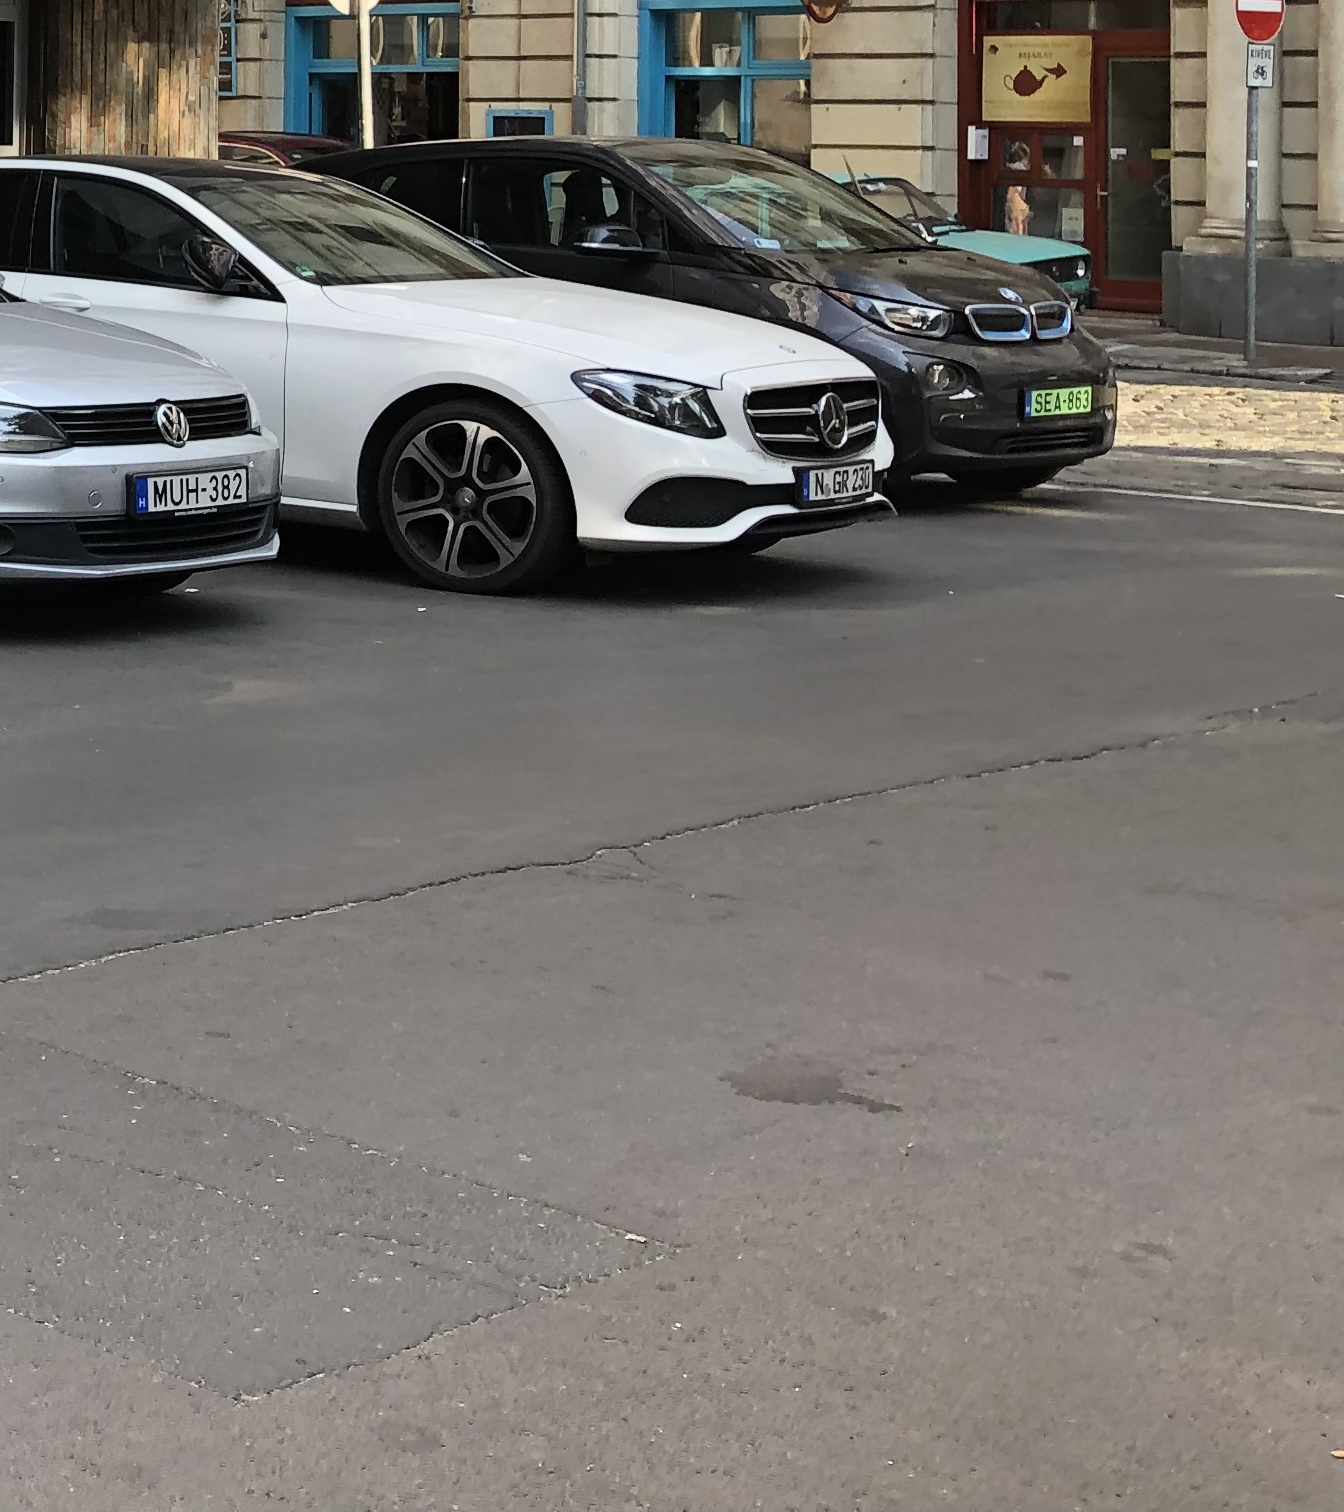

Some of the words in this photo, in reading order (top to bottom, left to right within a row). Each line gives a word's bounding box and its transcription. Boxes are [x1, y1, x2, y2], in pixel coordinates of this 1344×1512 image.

[1034, 390, 1090, 414] SEA-863
[153, 472, 243, 509] MUH-382
[814, 471, 825, 497] N
[833, 469, 849, 495] GR
